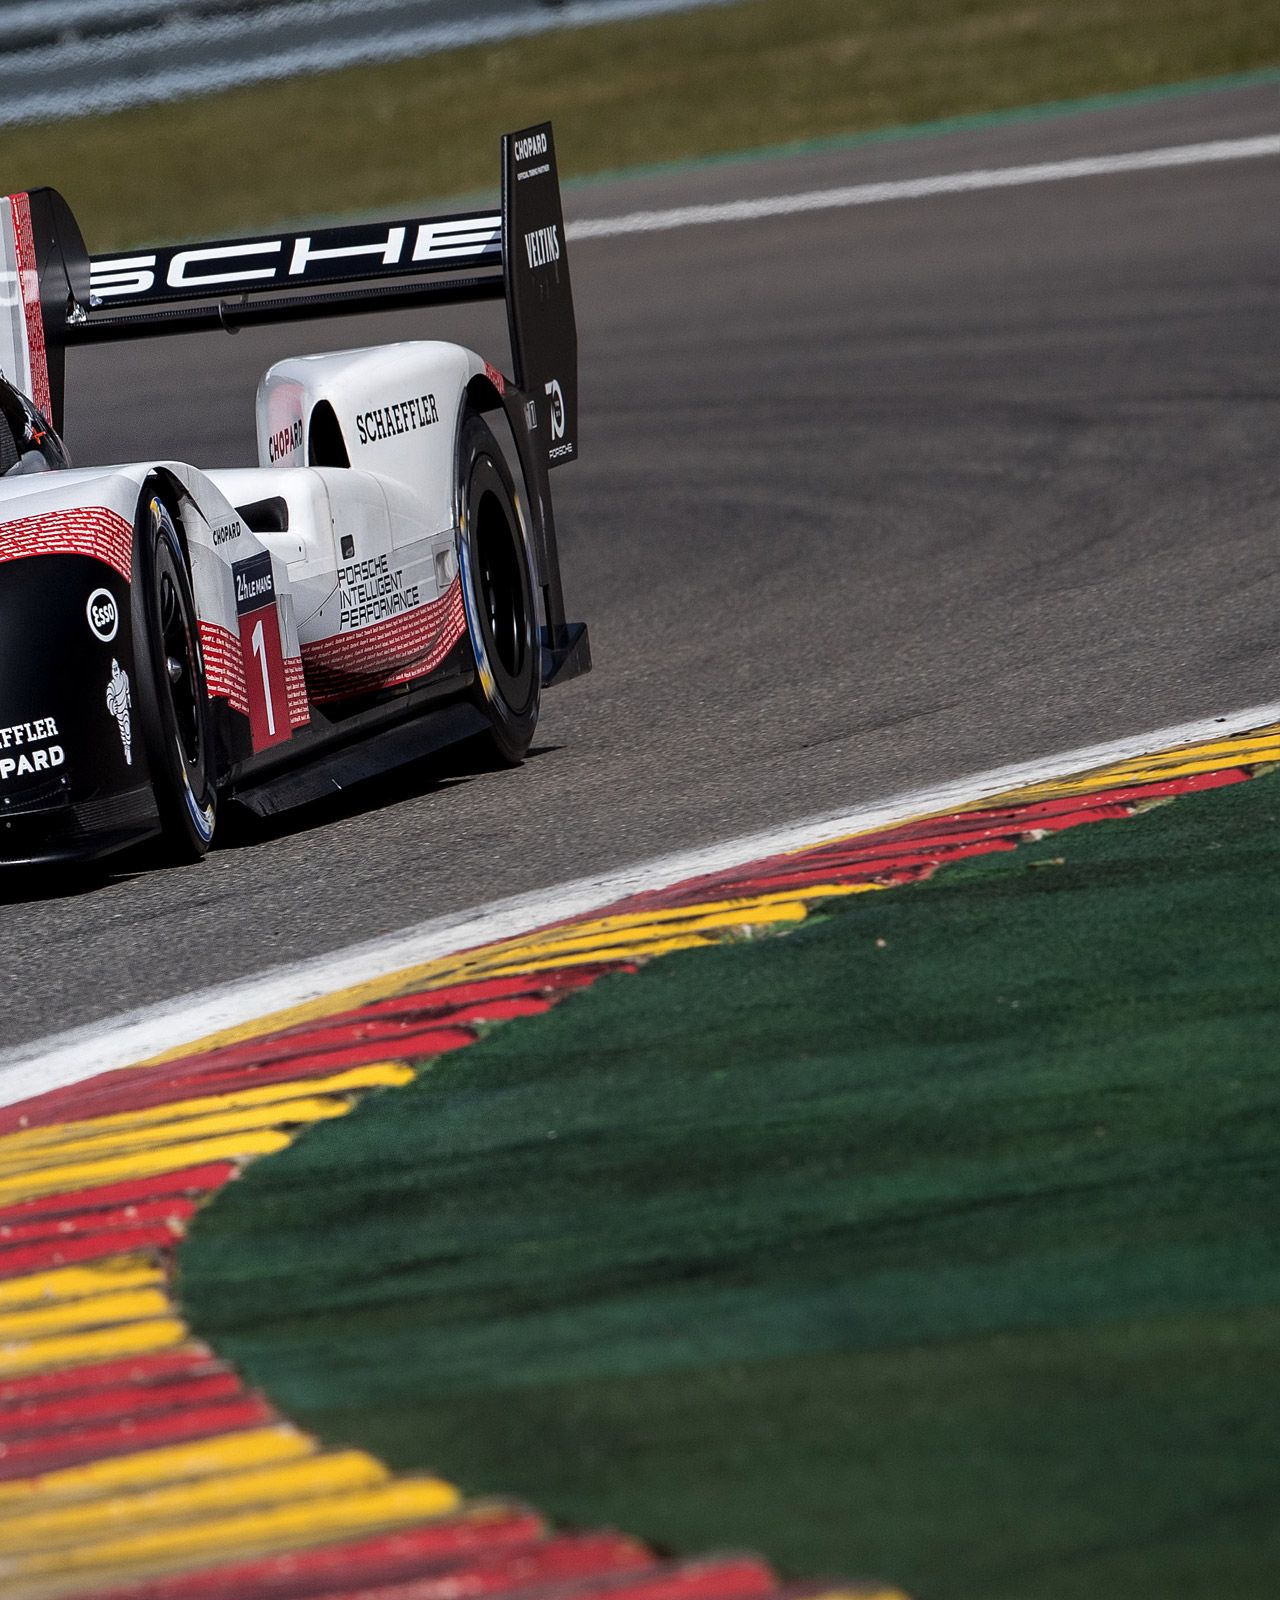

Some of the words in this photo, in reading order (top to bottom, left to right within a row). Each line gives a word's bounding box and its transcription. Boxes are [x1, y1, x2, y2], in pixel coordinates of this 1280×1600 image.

[515, 133, 547, 161] CHOPARD
[89, 216, 503, 297] SCHE
[524, 225, 560, 268] VELTINS
[356, 394, 439, 445] SCHAEFFLER
[269, 419, 303, 463] CHOPARD
[549, 443, 573, 460] PORSCHE
[212, 521, 241, 546] CHOPARD
[249, 581, 257, 596] LE
[256, 574, 272, 593] MANS
[337, 555, 388, 588] PORSCHE
[340, 570, 402, 609] INTELLIGENT
[340, 586, 420, 630] PERFORMANCE
[252, 620, 276, 736] 1
